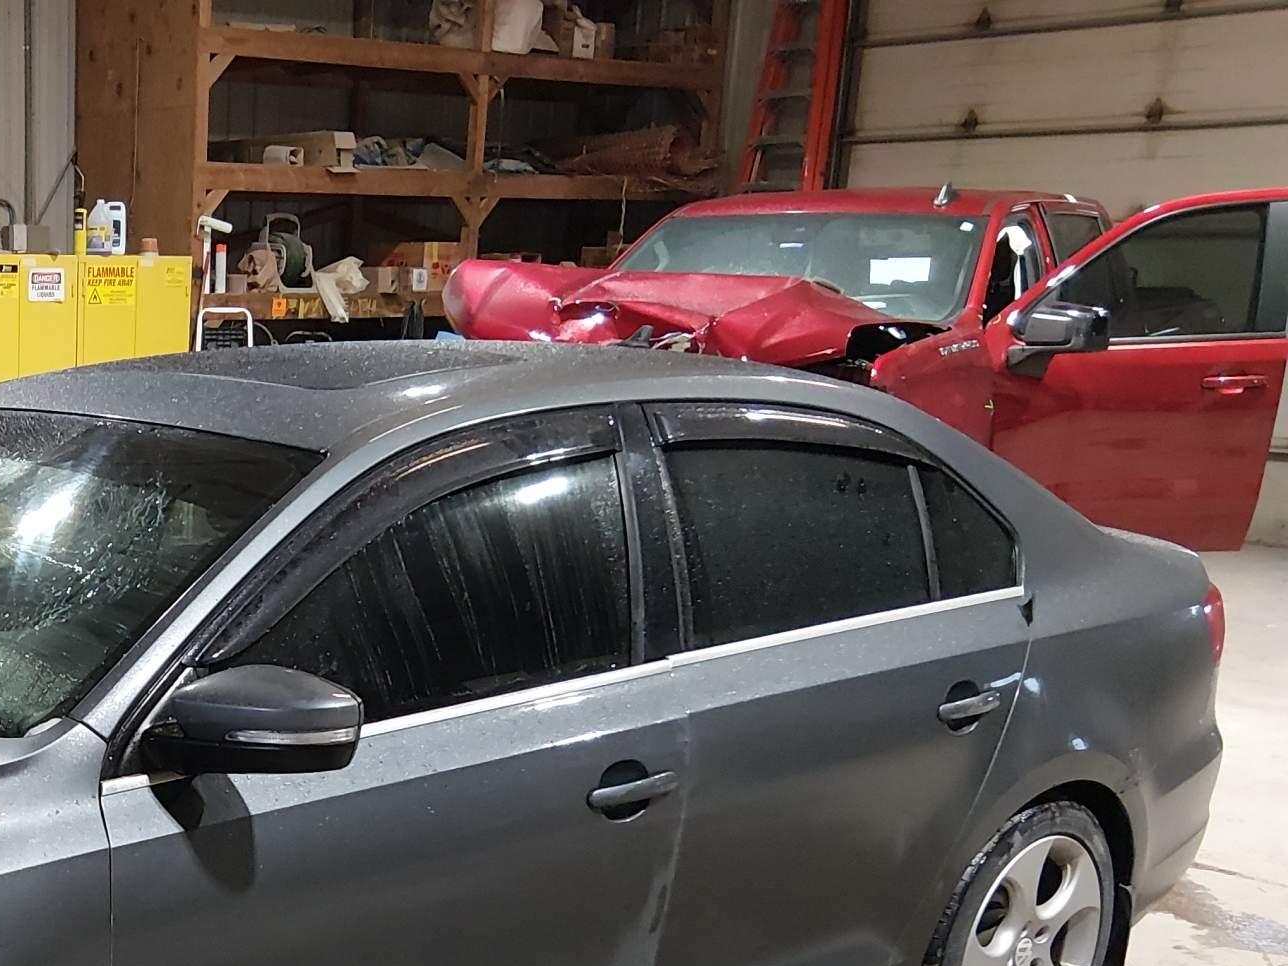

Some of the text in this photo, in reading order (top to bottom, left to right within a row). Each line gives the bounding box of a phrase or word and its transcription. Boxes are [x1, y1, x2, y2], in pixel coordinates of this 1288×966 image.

[88, 267, 134, 278] FLAMMABLE
[34, 274, 58, 283] DANGER
[88, 279, 133, 287] KEEP FIRE AWAY
